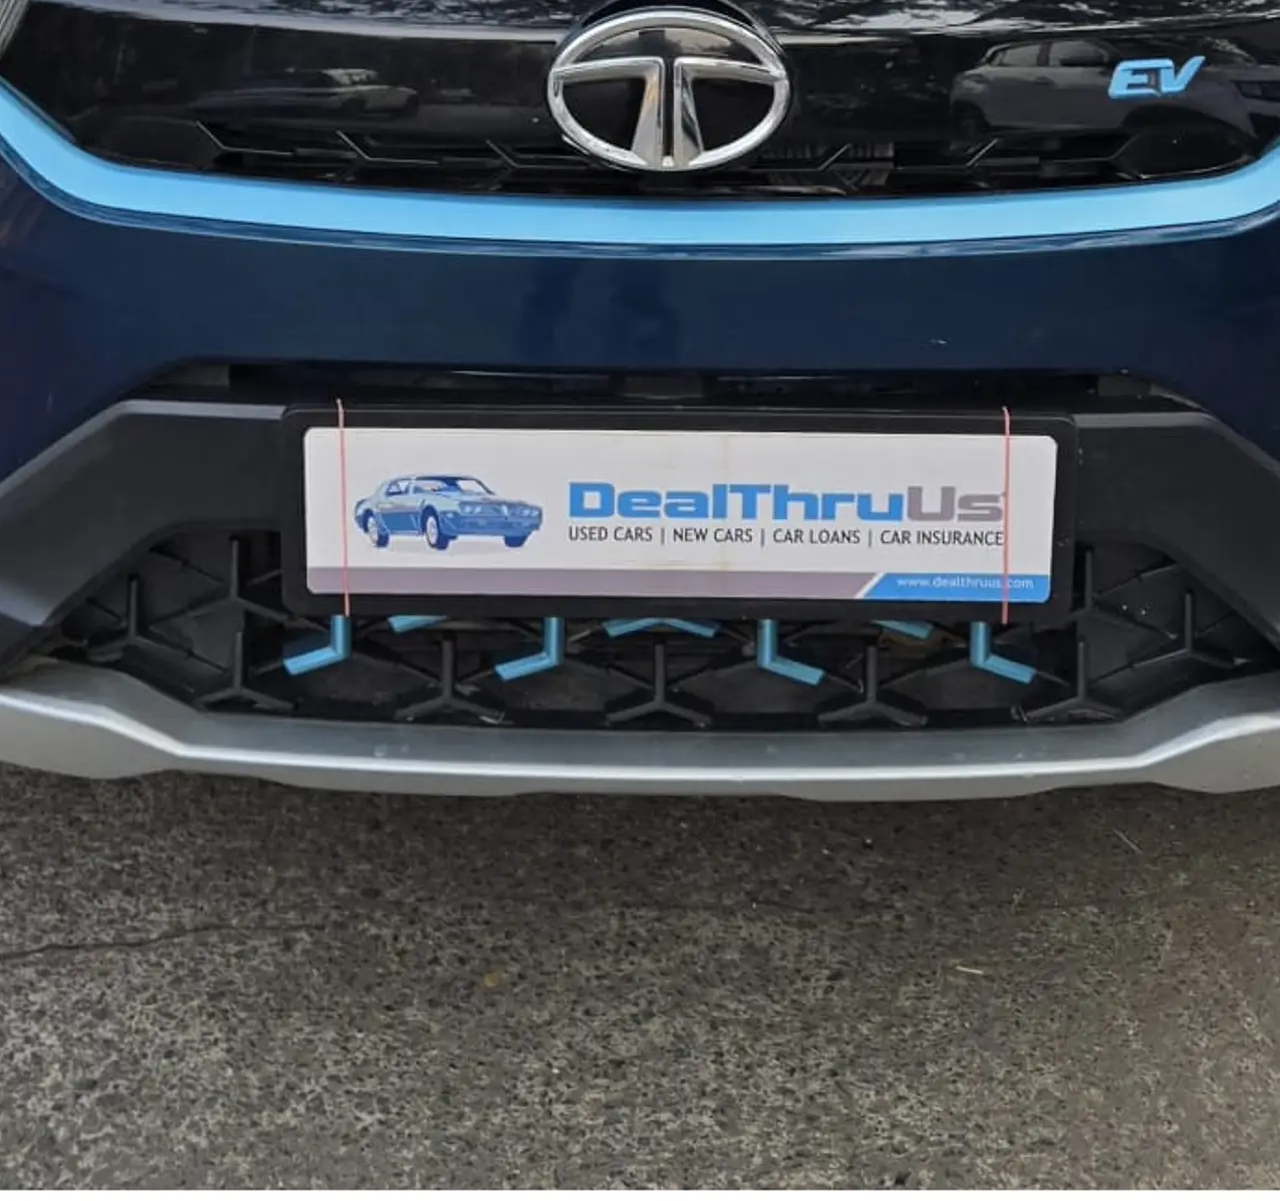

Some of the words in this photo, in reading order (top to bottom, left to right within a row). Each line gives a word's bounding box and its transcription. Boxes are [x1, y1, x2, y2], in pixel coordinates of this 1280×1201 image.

[1108, 55, 1206, 99] EV
[568, 482, 1004, 521] DealThruUs
[569, 526, 608, 542] USED
[613, 527, 653, 542] CARS
[673, 528, 708, 543] NEW
[713, 528, 753, 543] CARS
[772, 528, 804, 544] CAR
[809, 530, 861, 545] LOANS
[879, 530, 911, 545] CAR
[916, 530, 1004, 546] INSURANCE
